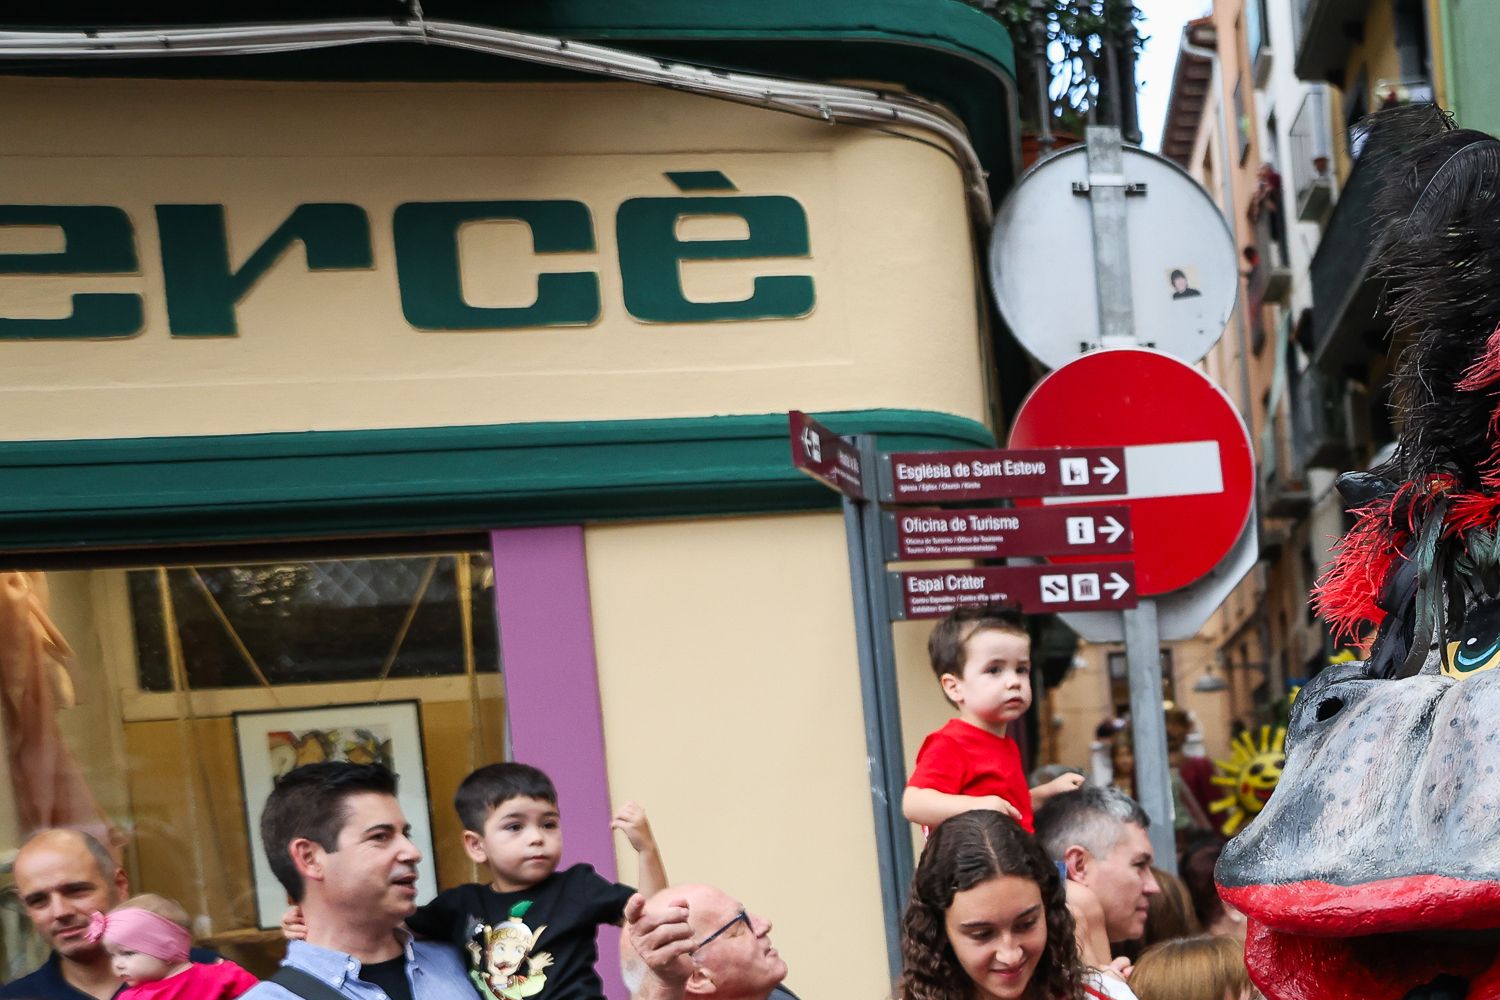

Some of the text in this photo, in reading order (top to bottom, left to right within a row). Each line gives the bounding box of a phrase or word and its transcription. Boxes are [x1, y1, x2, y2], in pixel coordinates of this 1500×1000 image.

[897, 459, 1046, 482] Església de Sant Esteve
[903, 515, 1020, 533] Oficina de Turisme
[908, 573, 986, 594] Espai Cràter
